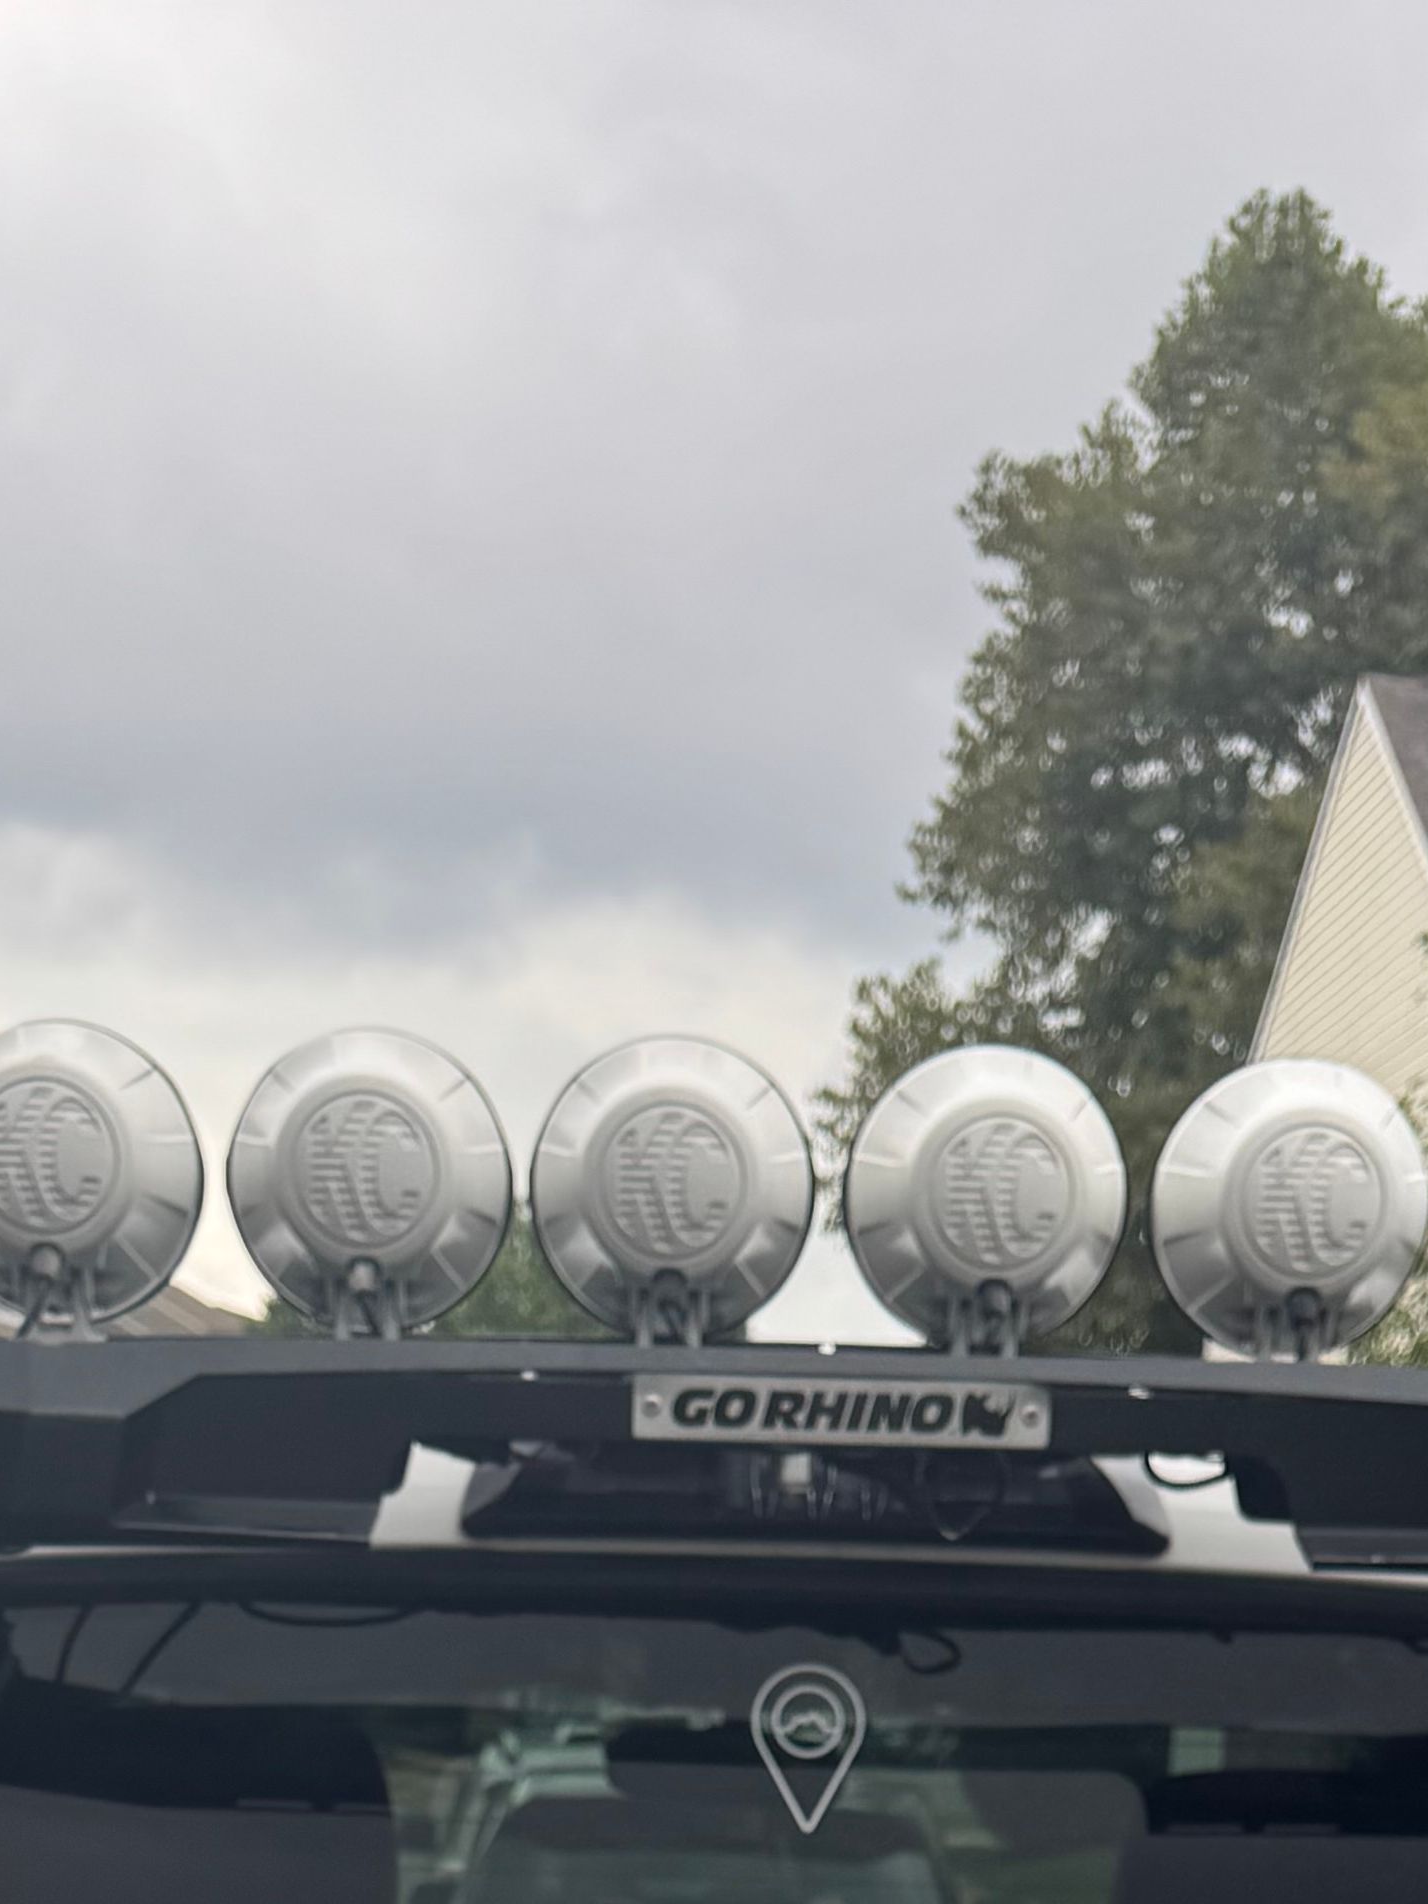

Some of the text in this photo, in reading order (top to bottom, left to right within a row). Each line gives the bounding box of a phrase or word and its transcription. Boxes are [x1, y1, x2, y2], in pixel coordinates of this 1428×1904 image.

[303, 1098, 424, 1242] KC
[614, 1113, 733, 1256] KC
[940, 1122, 1057, 1263] KC
[1253, 1132, 1371, 1273] KC
